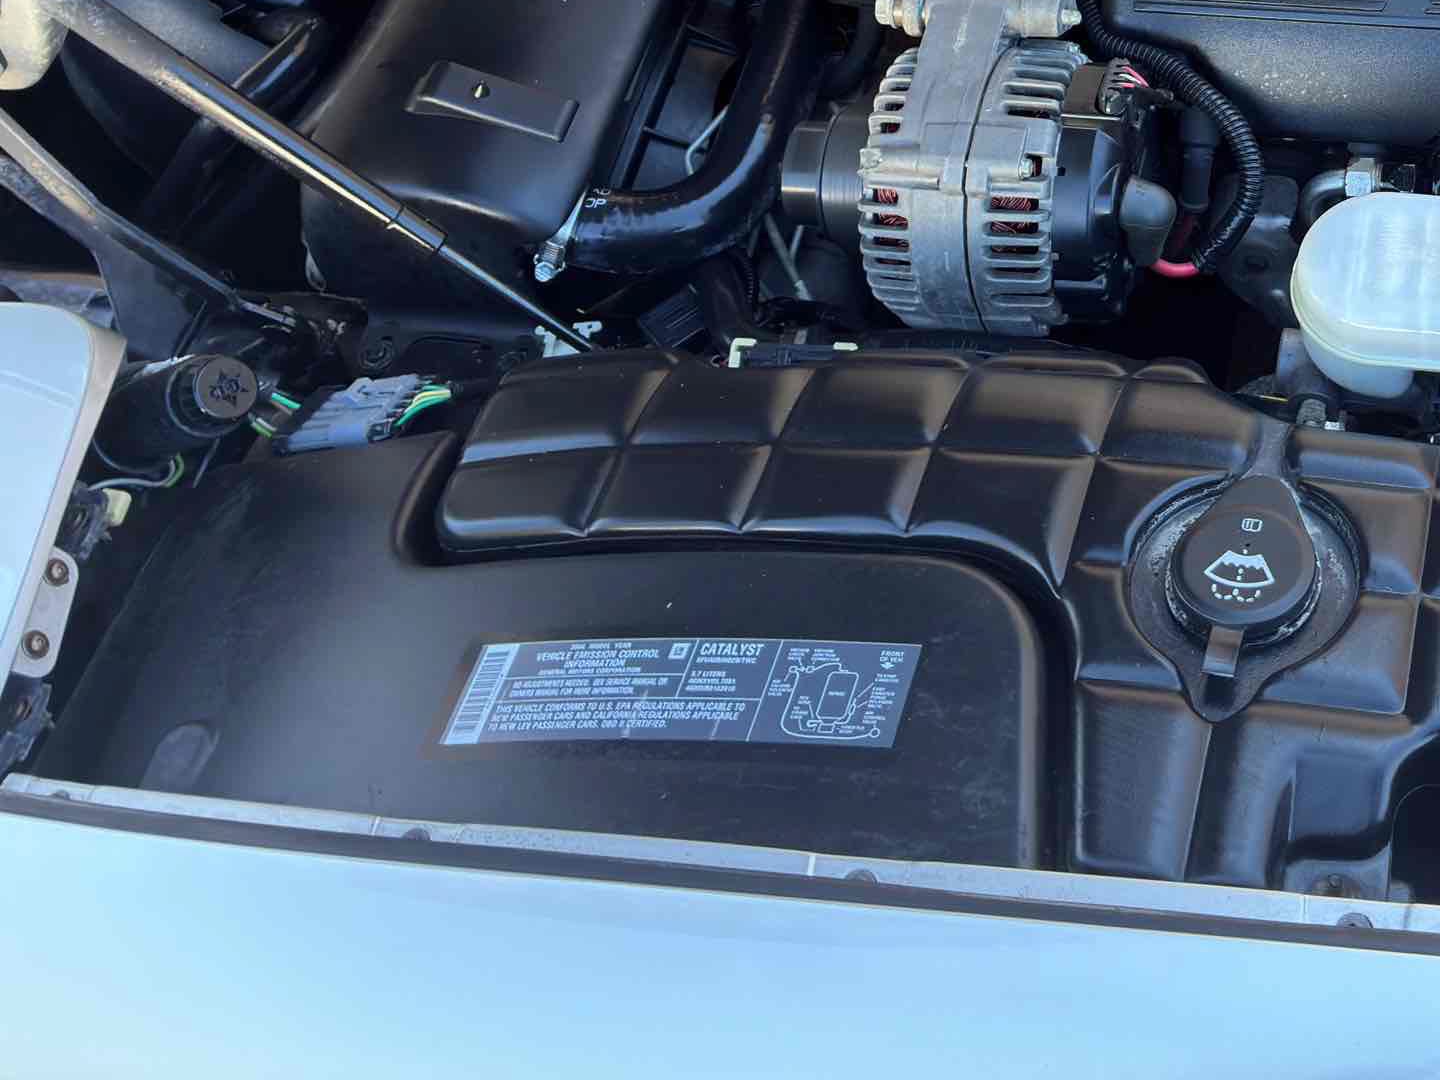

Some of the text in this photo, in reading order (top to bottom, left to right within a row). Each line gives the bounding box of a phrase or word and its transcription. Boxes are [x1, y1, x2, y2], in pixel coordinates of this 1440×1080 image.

[700, 643, 765, 656] CATALYST
[536, 652, 571, 662] VEHICLE
[573, 650, 617, 660] EMISSION
[618, 649, 660, 659] CONTROL
[563, 659, 626, 668] INFORMATION
[514, 703, 543, 712] VEHICLE
